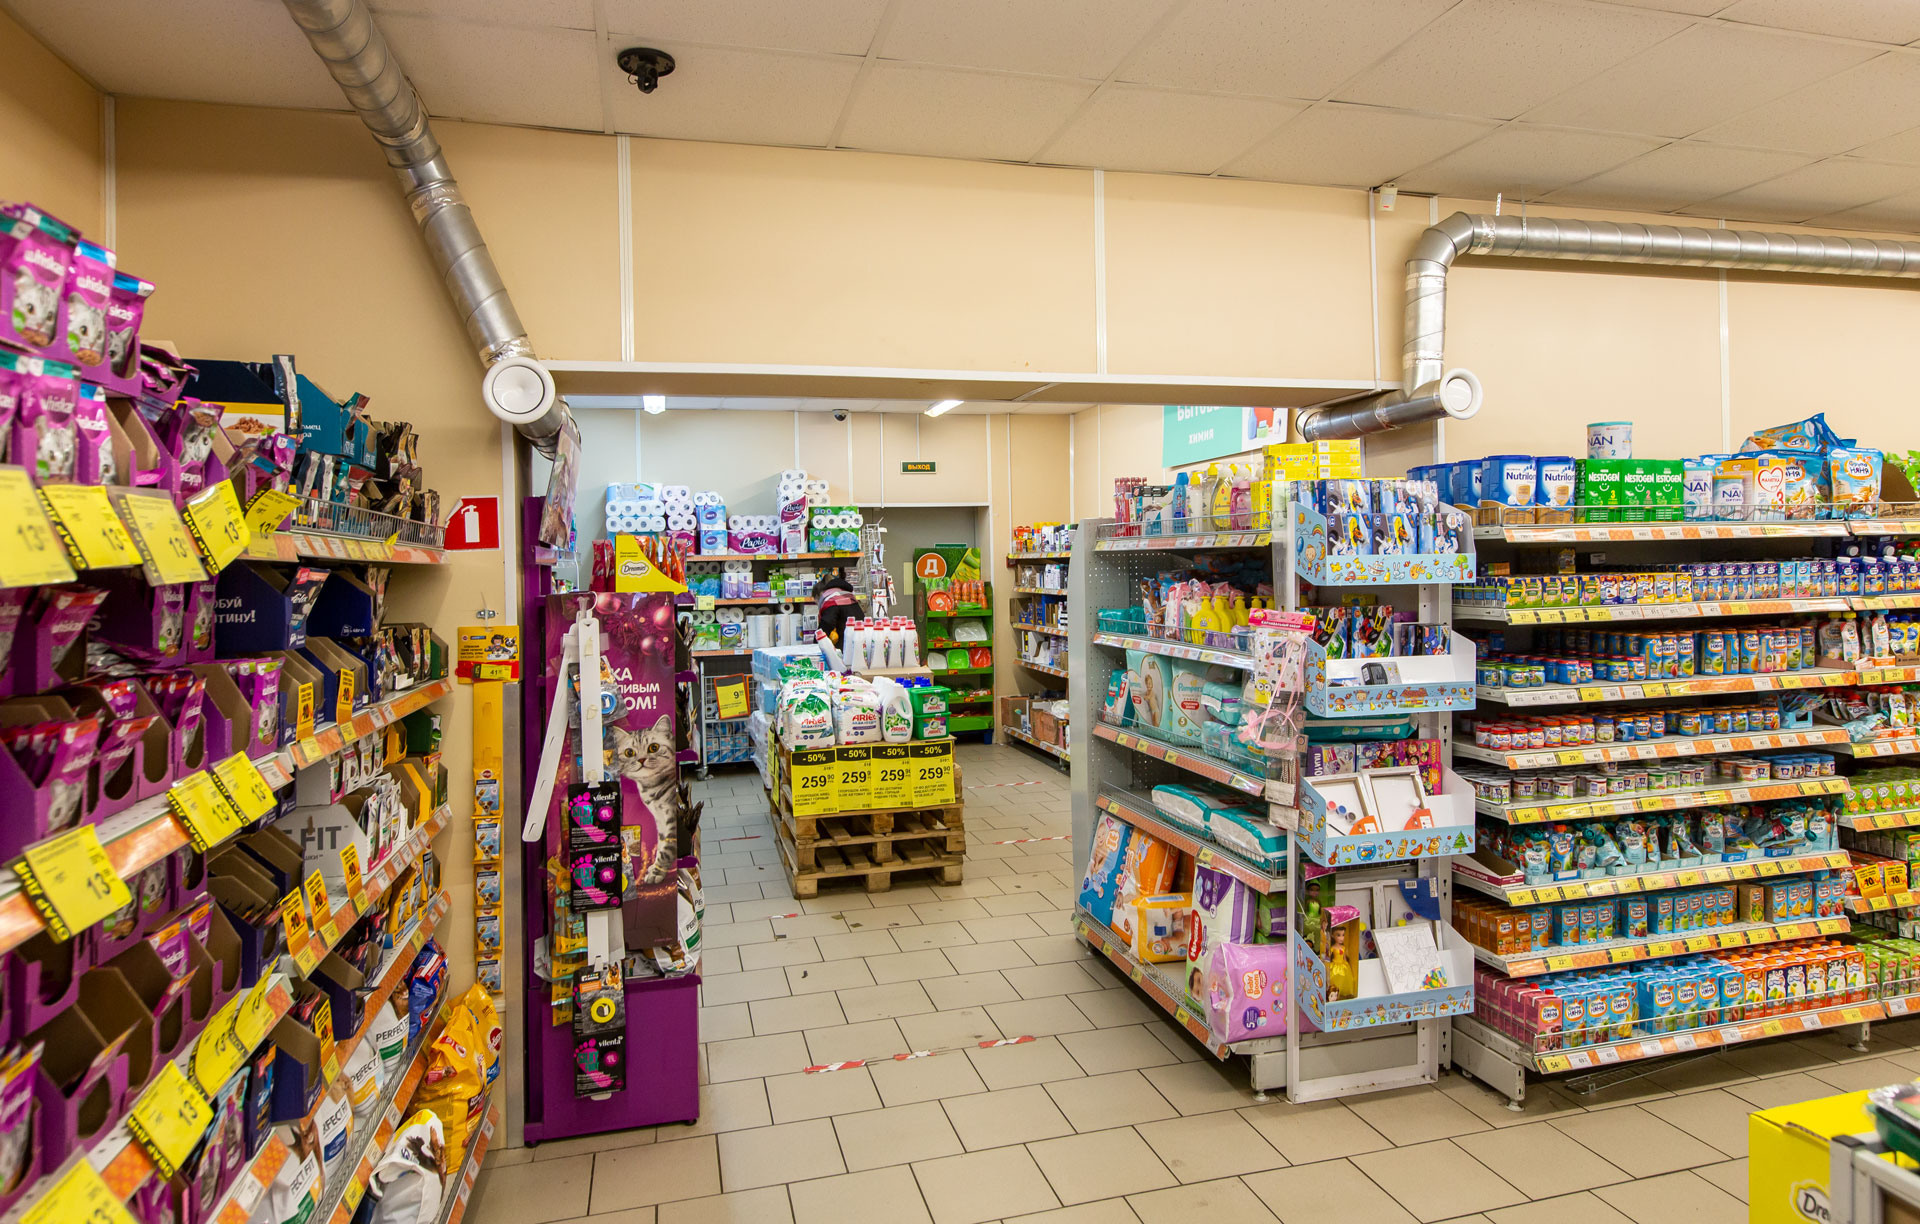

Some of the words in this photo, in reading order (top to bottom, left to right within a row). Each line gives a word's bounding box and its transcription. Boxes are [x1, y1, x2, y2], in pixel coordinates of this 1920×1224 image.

[1589, 472, 1620, 482] NESTOGEN
[1625, 473, 1655, 483] NESTOGEN
[1610, 490, 1616, 498] 3
[1645, 489, 1650, 498] 2
[1776, 491, 1784, 509] 3
[223, 521, 240, 544] 13
[741, 537, 767, 549] Papia
[925, 559, 938, 575] Д
[215, 610, 256, 624] ТИНУ!
[612, 667, 633, 681] КА
[618, 683, 660, 693] ЛИВЫМ
[624, 695, 657, 710] ОМ!
[801, 718, 827, 726] ARIEL
[852, 714, 877, 722] ARIEL
[882, 748, 905, 756] -50%
[920, 746, 942, 754] -50%
[803, 754, 827, 762] -50%
[842, 772, 867, 783] 259
[881, 770, 905, 781] 259
[920, 767, 943, 780] 259
[802, 776, 827, 788] 259
[593, 793, 615, 801] vilenta
[212, 805, 230, 825] 13
[301, 826, 342, 850] FIT
[594, 855, 617, 863] vilenta
[86, 871, 111, 900] 13
[376, 1021, 405, 1043] PERFECT
[599, 1039, 620, 1047] vilenta
[178, 1100, 198, 1127] 13
[289, 1171, 307, 1198] FECT
